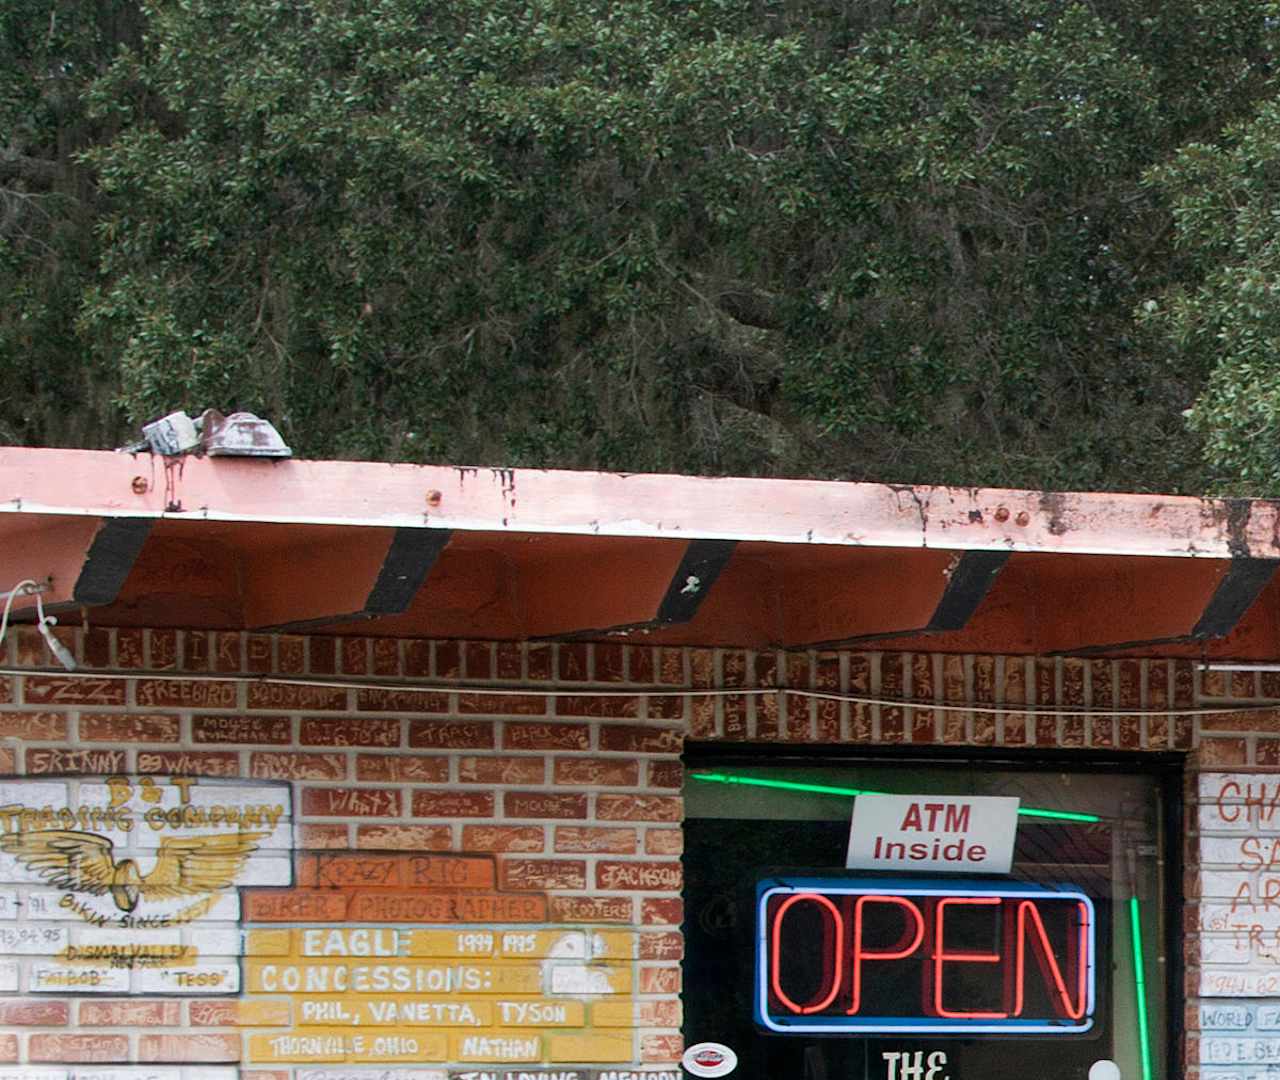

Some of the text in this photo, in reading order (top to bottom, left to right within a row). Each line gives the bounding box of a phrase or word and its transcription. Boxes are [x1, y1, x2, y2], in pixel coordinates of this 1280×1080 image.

[901, 803, 972, 833] ATM
[873, 836, 988, 862] Inside
[304, 929, 413, 957] EAGLE
[771, 893, 1088, 1020] OPEN
[261, 965, 492, 992] CONCESSIONS:
[303, 1002, 566, 1026] PHIL, VANETTA, TYSON
[1201, 1009, 1254, 1027] WORLD
[462, 1037, 539, 1059] NATHAN
